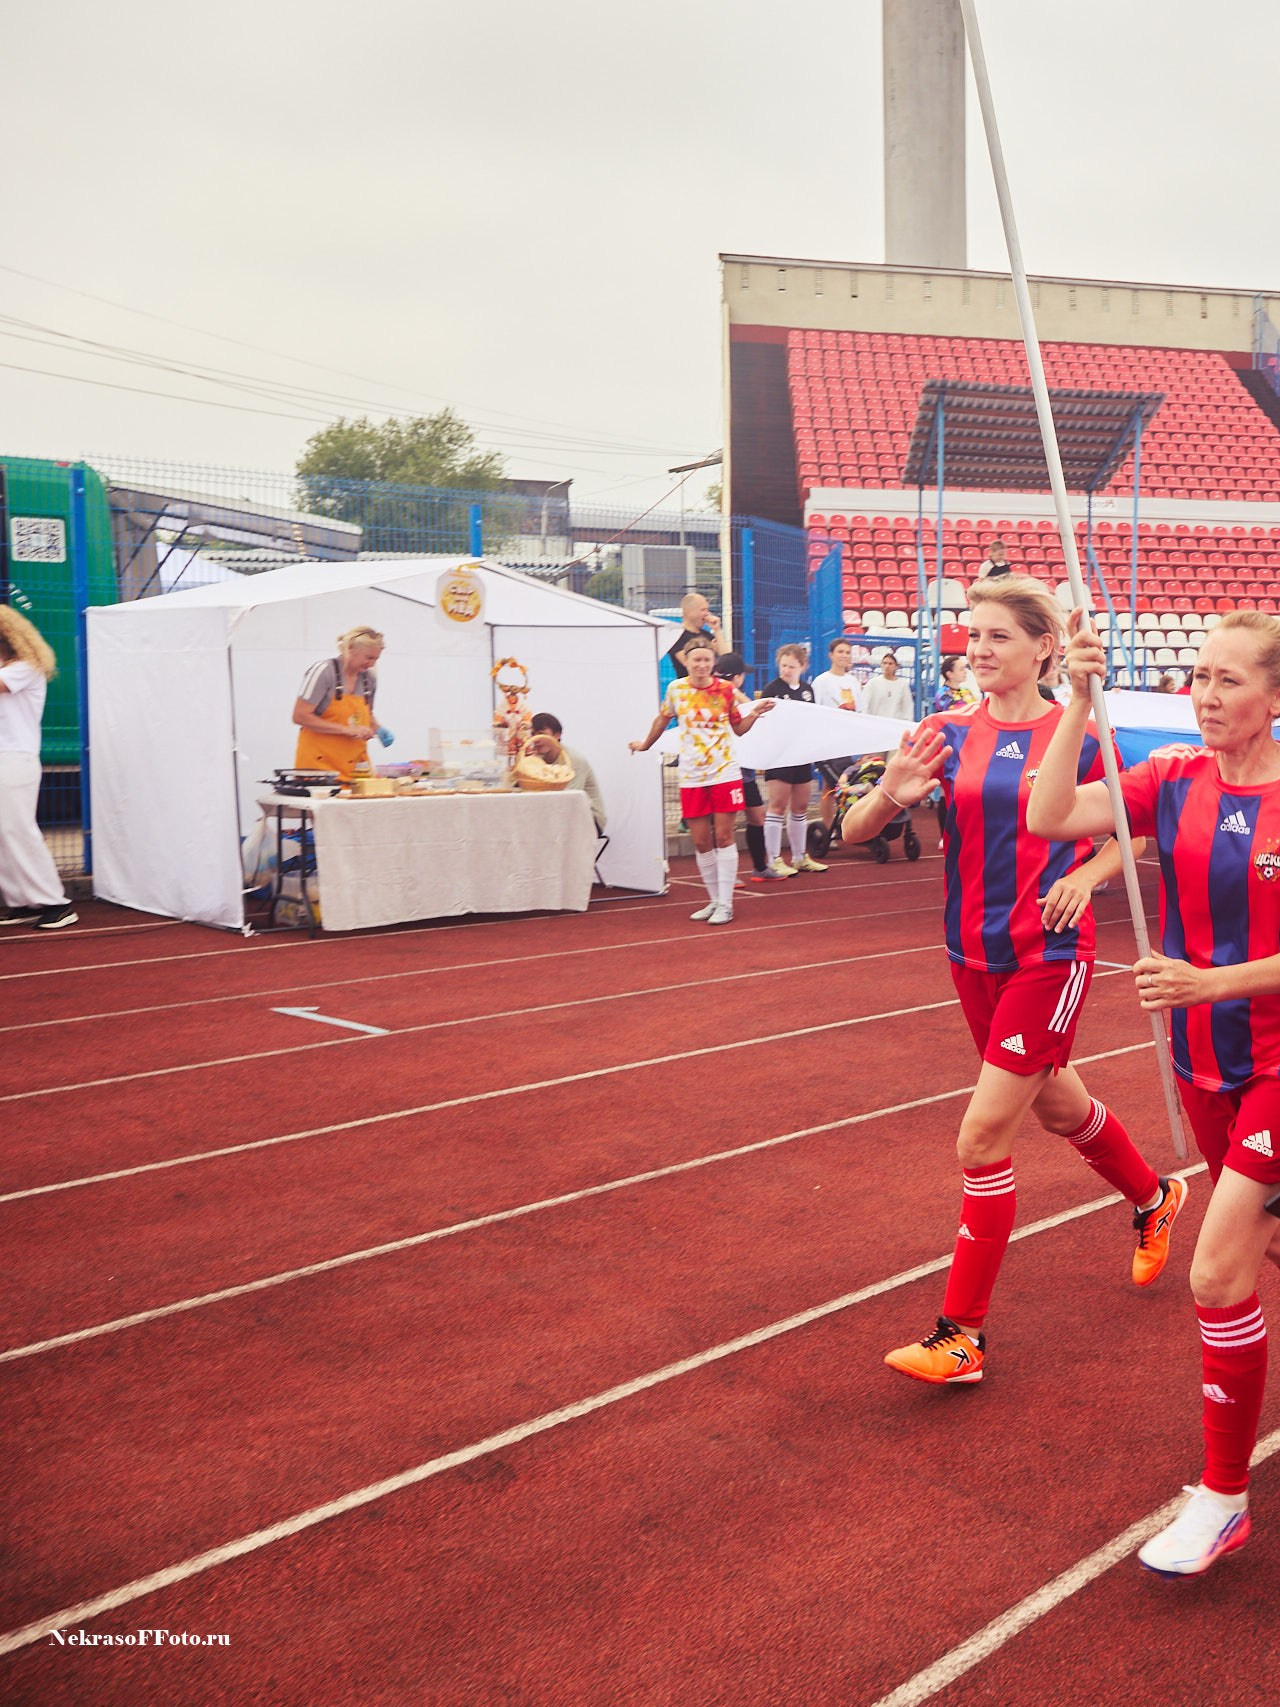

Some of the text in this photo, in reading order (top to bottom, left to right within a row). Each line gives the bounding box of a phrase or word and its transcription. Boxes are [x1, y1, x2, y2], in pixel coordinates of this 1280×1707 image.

[995, 750, 1024, 760] adidas
[1220, 823, 1251, 835] adidas
[1000, 1040, 1027, 1056] adidas
[1241, 1138, 1274, 1158] adidas
